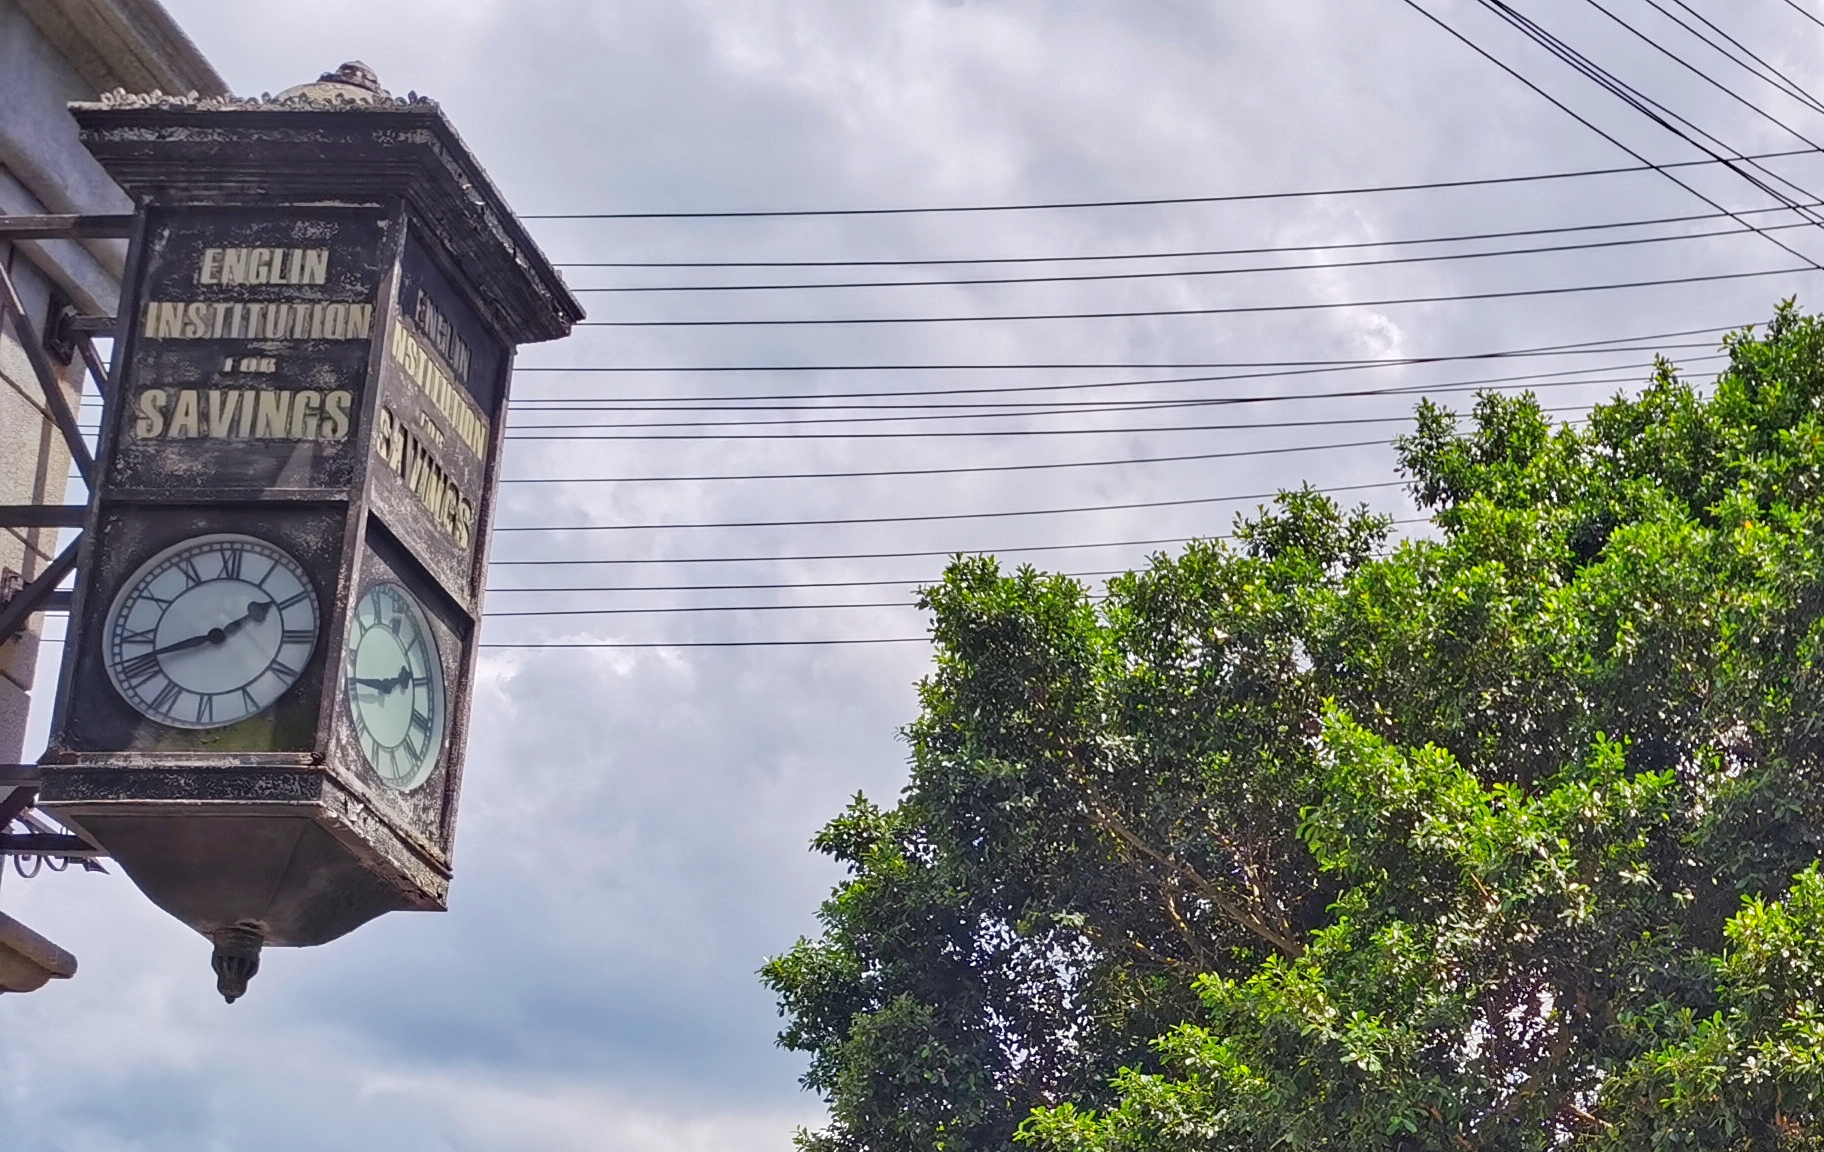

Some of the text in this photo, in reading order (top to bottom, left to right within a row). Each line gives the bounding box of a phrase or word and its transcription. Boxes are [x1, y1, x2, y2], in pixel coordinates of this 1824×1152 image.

[200, 248, 329, 285] ENGLIN
[144, 302, 372, 339] INSTITUTION
[223, 356, 277, 373] FOR
[136, 389, 352, 440] SAVINGS
[376, 406, 472, 550] SAVINGS
